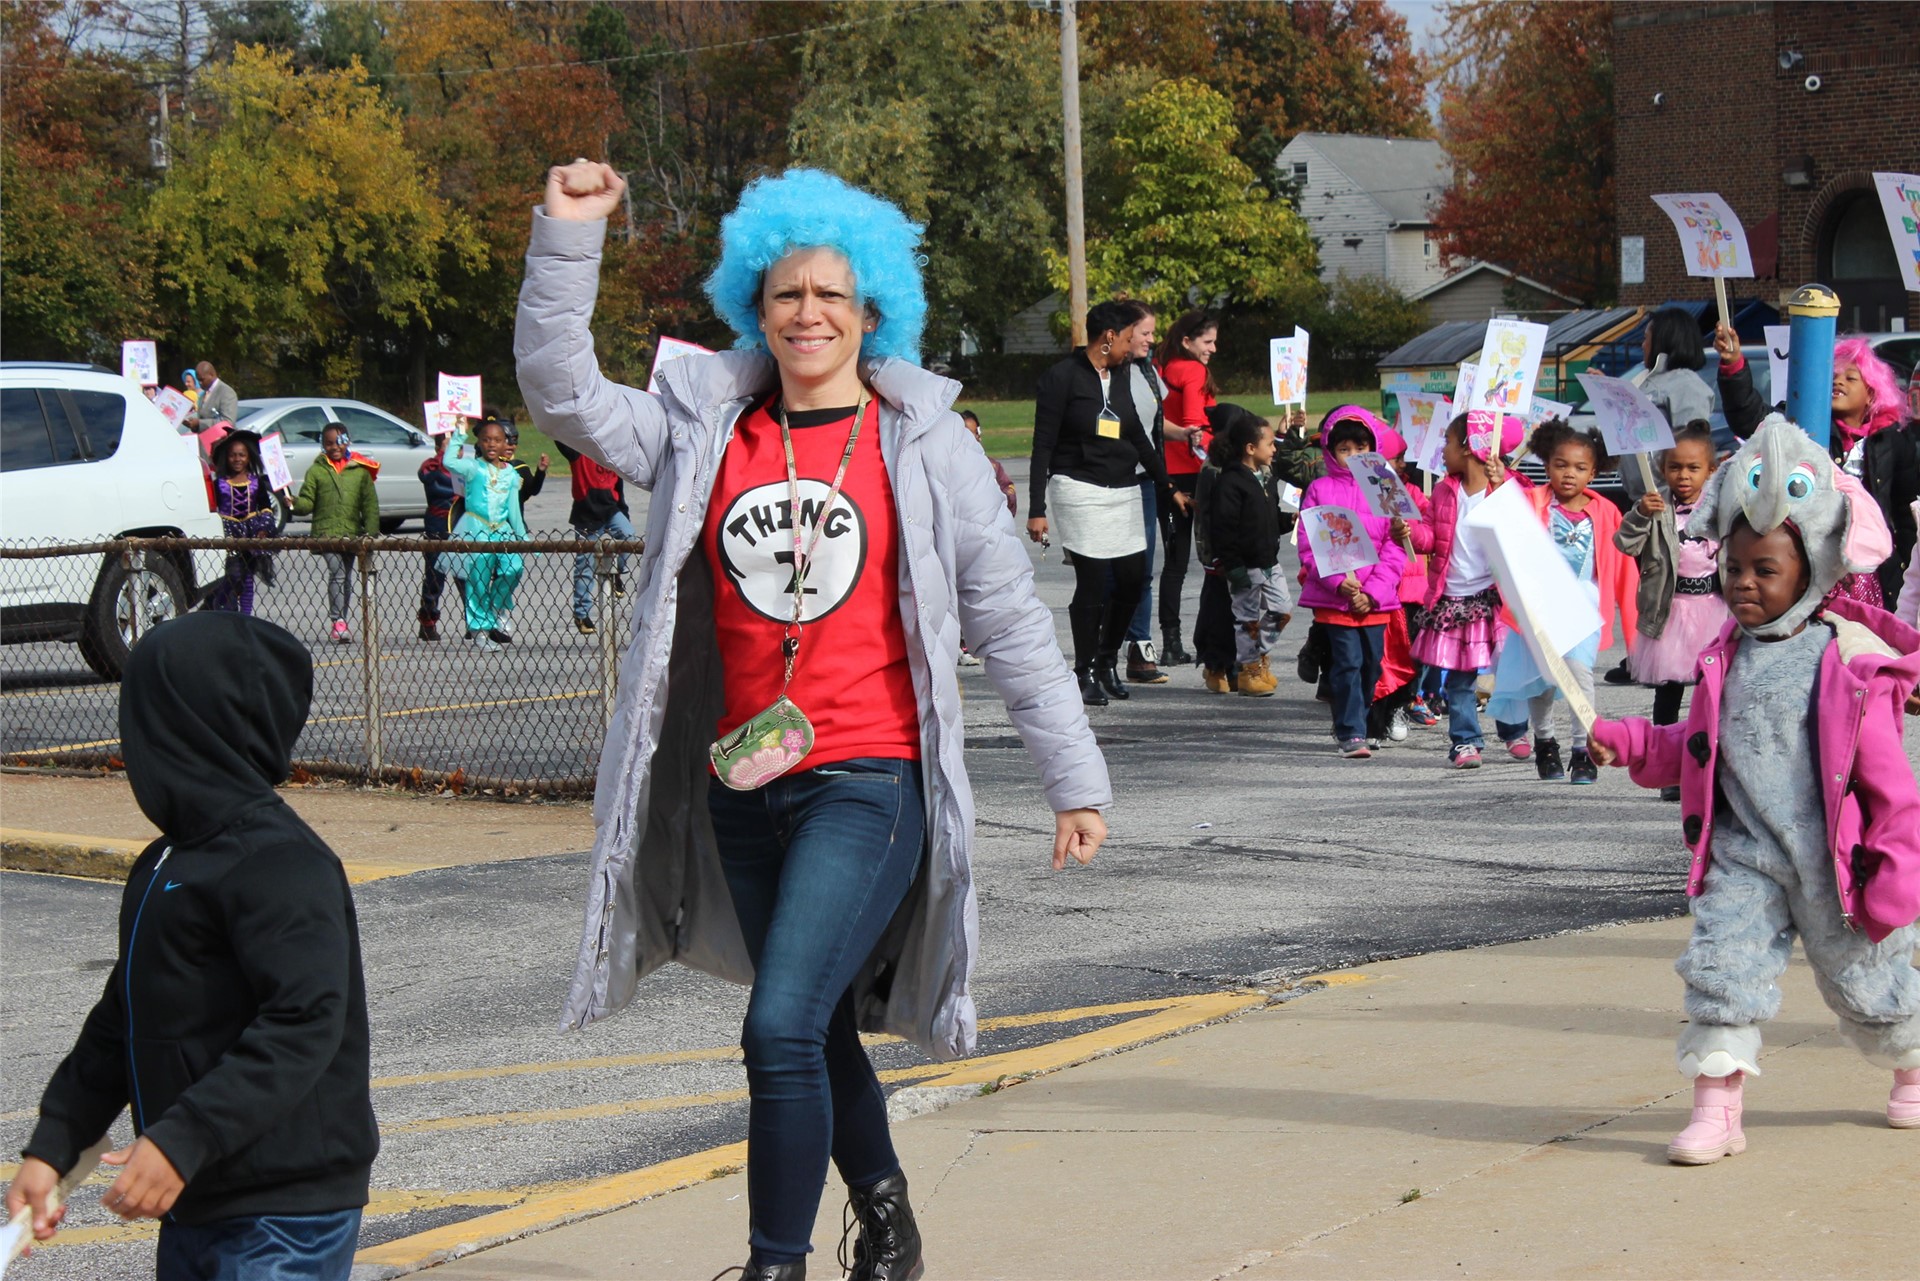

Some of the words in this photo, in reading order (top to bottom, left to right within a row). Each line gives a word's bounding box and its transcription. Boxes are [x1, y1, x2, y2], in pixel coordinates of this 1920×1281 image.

[1424, 381, 1454, 392] RECYCLING
[1430, 370, 1447, 380] PAPER
[727, 497, 852, 547] THING
[774, 551, 817, 594] 2
